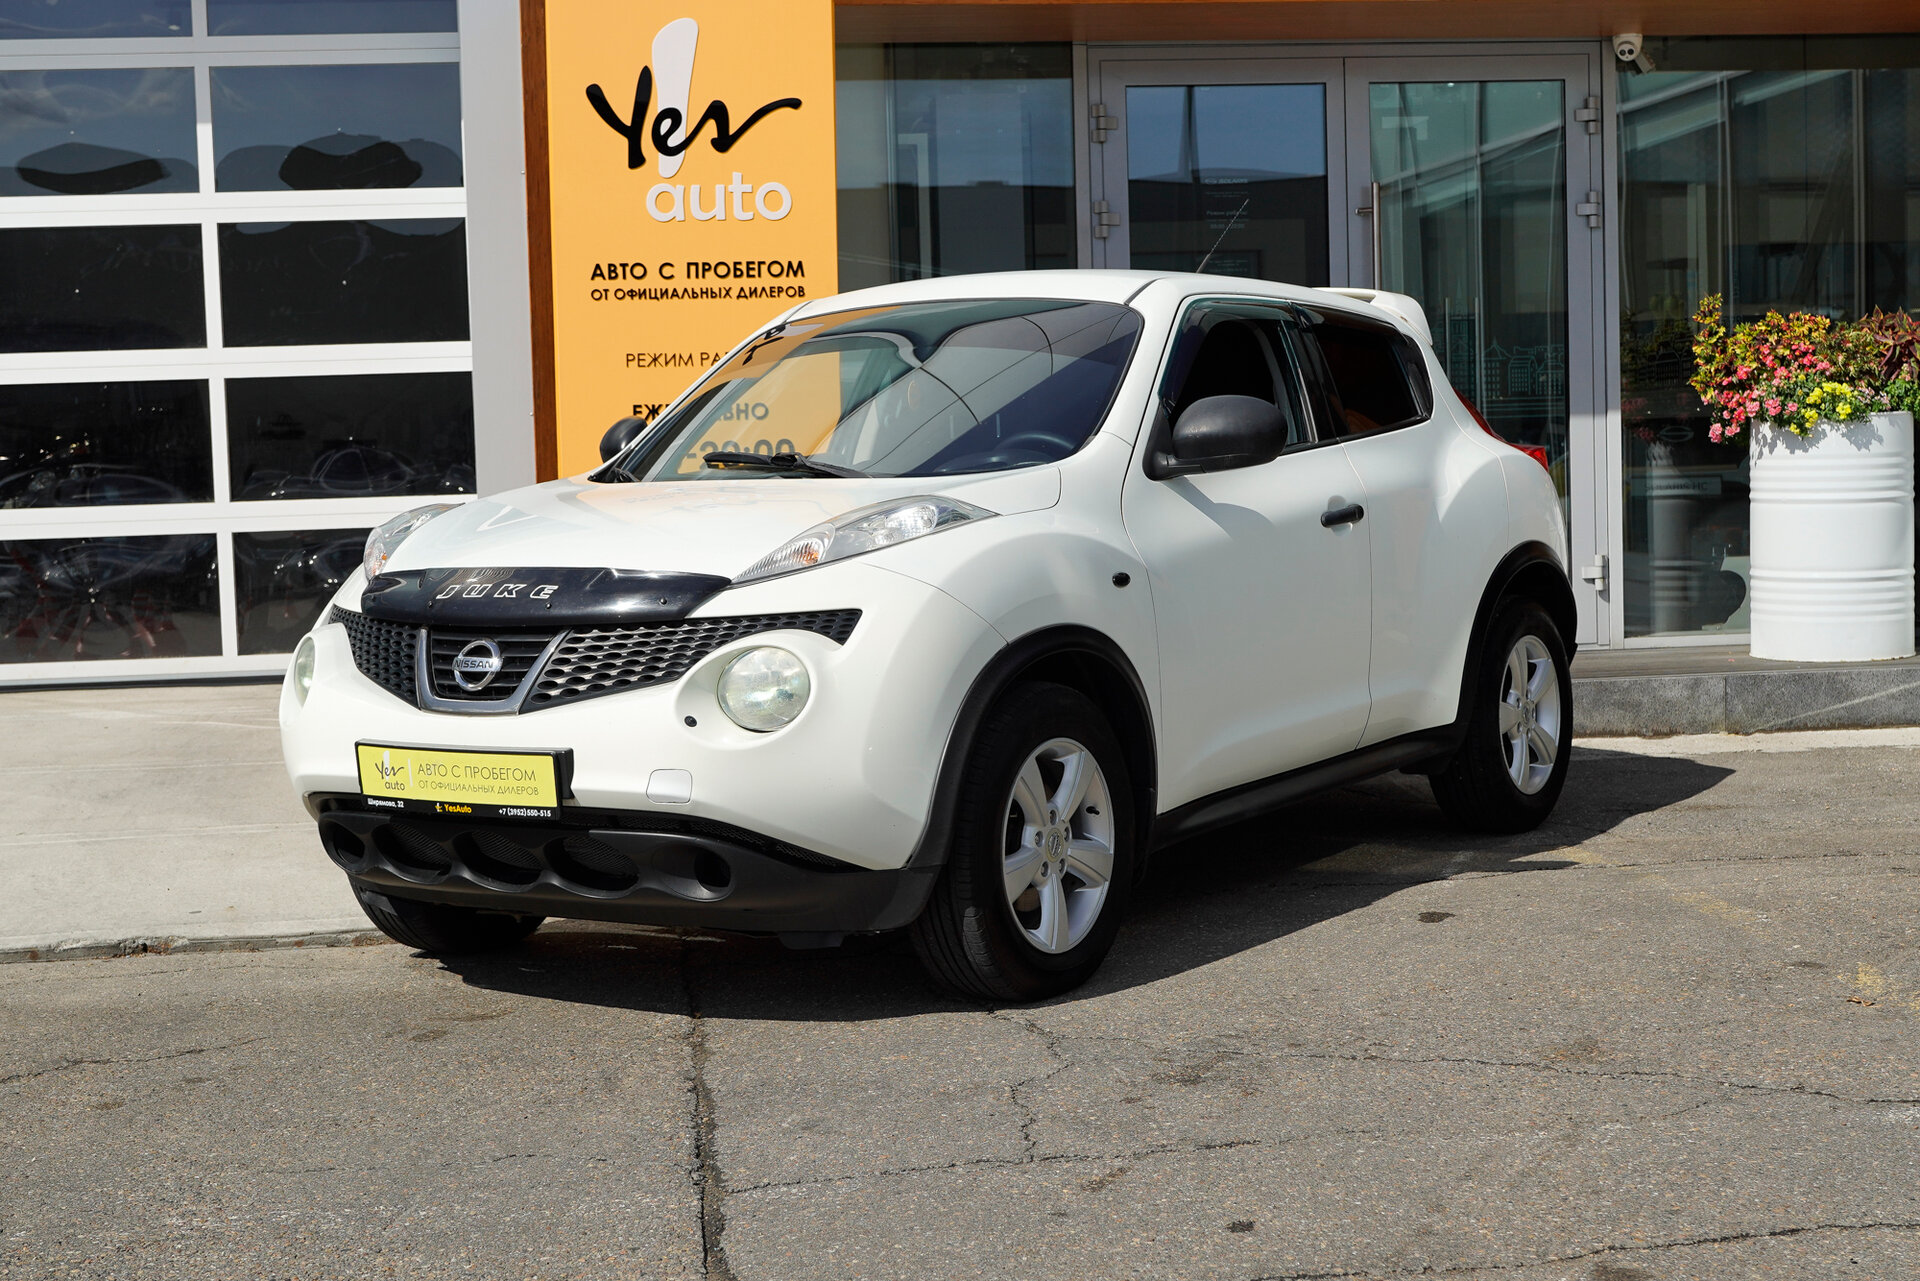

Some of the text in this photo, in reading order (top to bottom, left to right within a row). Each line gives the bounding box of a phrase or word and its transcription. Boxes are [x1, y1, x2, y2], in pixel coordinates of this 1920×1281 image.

[585, 65, 802, 170] Yes
[645, 172, 793, 222] auto
[590, 260, 805, 281] АВТО С ПРОБЕГОМ
[591, 285, 806, 302] ОТ ОФИЦИАЛЬНЫХ ДИЛЕРОВ
[626, 352, 694, 368] РЕЖИМ
[436, 583, 559, 600] JUKE
[454, 658, 494, 669] NISSAN
[418, 763, 537, 782] АВТО С ПРОБЕГОМ
[384, 781, 406, 791] auto
[418, 780, 539, 796] ОТ ОФИЦИАЛЬНЫХ ДИЛЕРОВ
[444, 804, 472, 814] YesAuto
